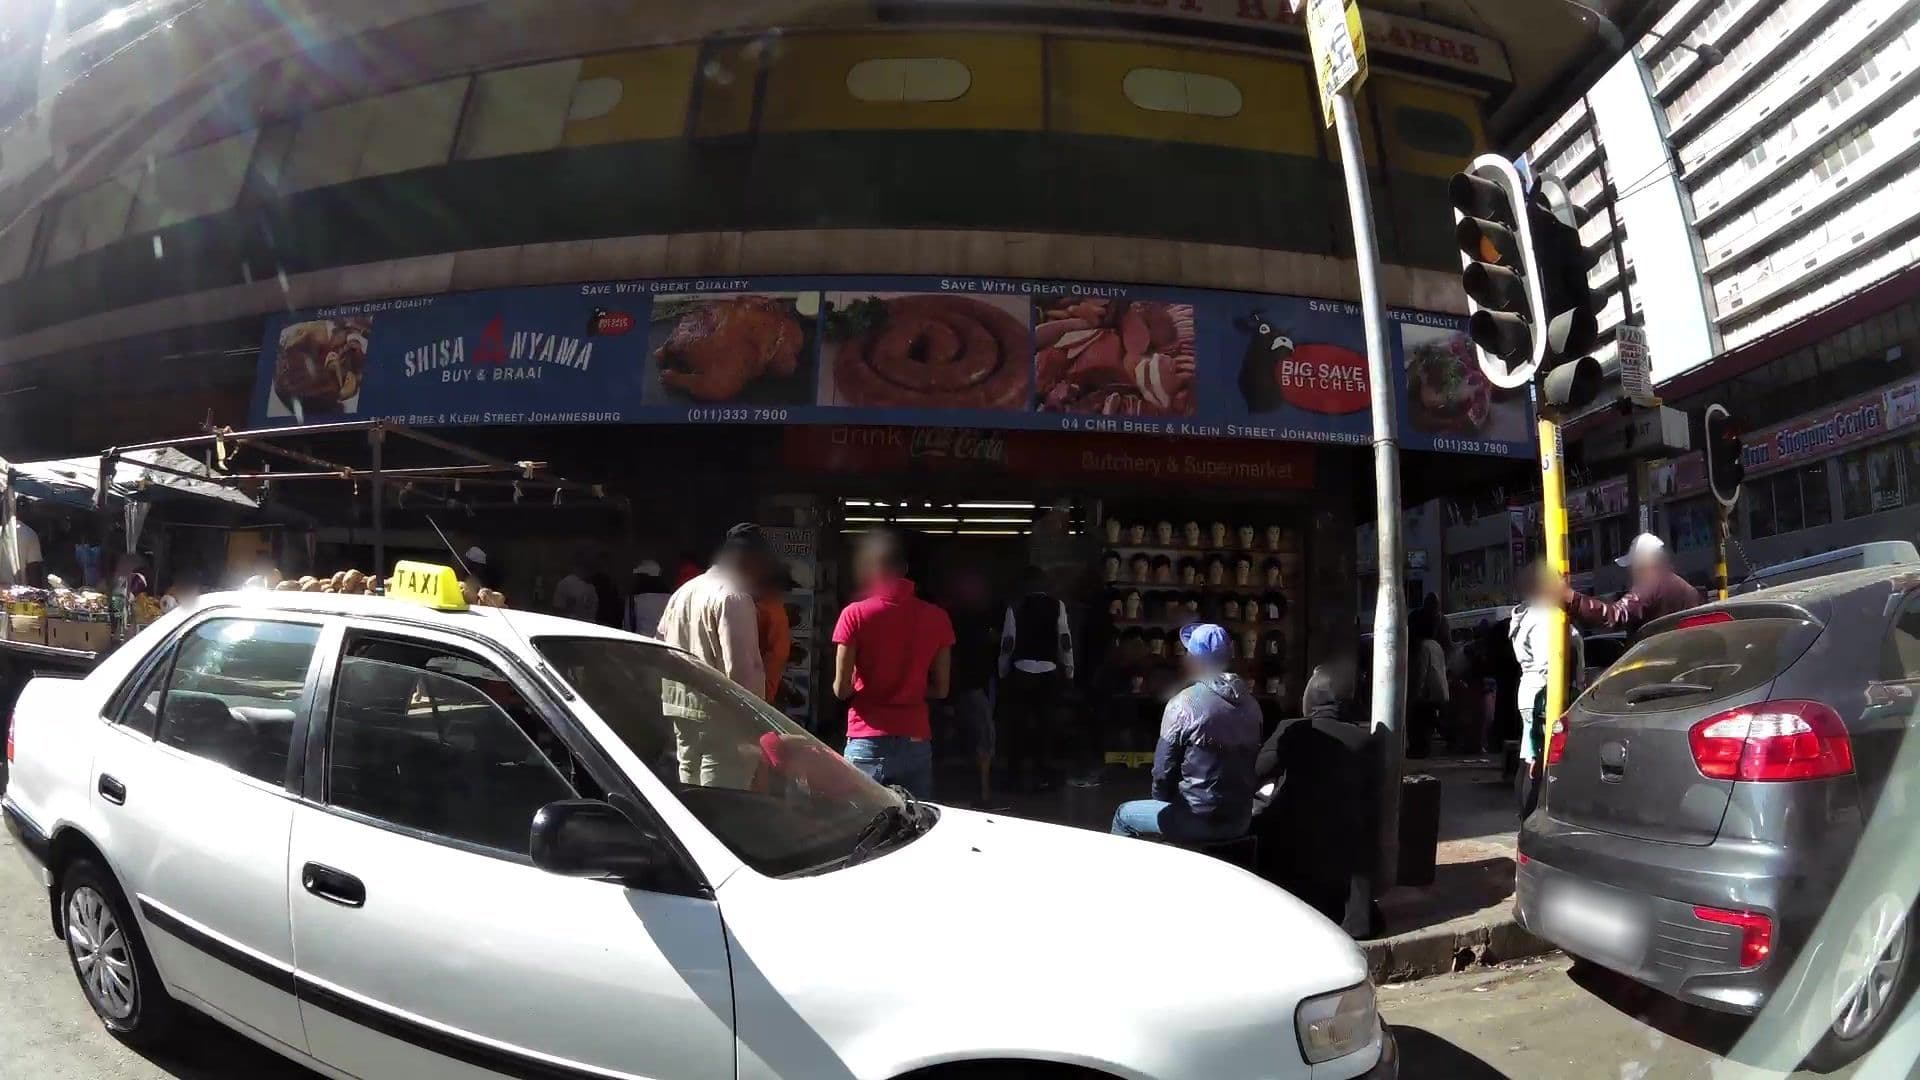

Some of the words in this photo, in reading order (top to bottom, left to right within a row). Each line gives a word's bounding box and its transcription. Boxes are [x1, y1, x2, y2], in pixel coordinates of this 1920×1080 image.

[581, 284, 610, 296] SAVE
[616, 283, 646, 294] WITH
[650, 282, 690, 293] GREAT
[695, 280, 749, 291] QUALITY
[940, 279, 976, 291] SAVE
[982, 280, 1015, 293] WITH
[1021, 282, 1066, 295] GREAT
[1071, 284, 1128, 297] QUALITY
[316, 308, 337, 318] SAVE
[340, 304, 361, 316] WITH
[363, 302, 392, 314] GREAT
[395, 299, 434, 311] QUALITY
[1309, 301, 1340, 314] SAVE
[1416, 314, 1460, 329] QUALITY
[404, 336, 465, 378] SHISA
[510, 331, 593, 371] NYAMA
[441, 368, 471, 383] BUY
[477, 370, 486, 381] &
[493, 366, 542, 382] BRAAI
[1281, 360, 1314, 378] BIG
[1318, 363, 1364, 382] SAVE
[409, 414, 435, 425] BREE
[438, 414, 445, 424] &
[450, 412, 479, 424] KLEIN
[483, 411, 524, 424] STREET
[528, 411, 621, 424] JOHANNESBURG
[687, 408, 748, 422] (011)333
[754, 409, 788, 421] 7900
[1061, 418, 1078, 430] 04
[1085, 418, 1117, 431] CNR
[1123, 420, 1160, 433] BREE
[1166, 423, 1175, 434] &
[1181, 424, 1220, 436] KLEIN
[1227, 424, 1275, 438] STREET
[1776, 421, 1835, 457] Shopping
[1834, 404, 1881, 438] Center
[1433, 437, 1480, 453] (011)333
[1484, 442, 1509, 455] 7900
[1080, 450, 1162, 479] Butchery
[1167, 456, 1180, 472] &
[1184, 456, 1295, 480] Supermarket
[398, 569, 439, 597] TAXI
